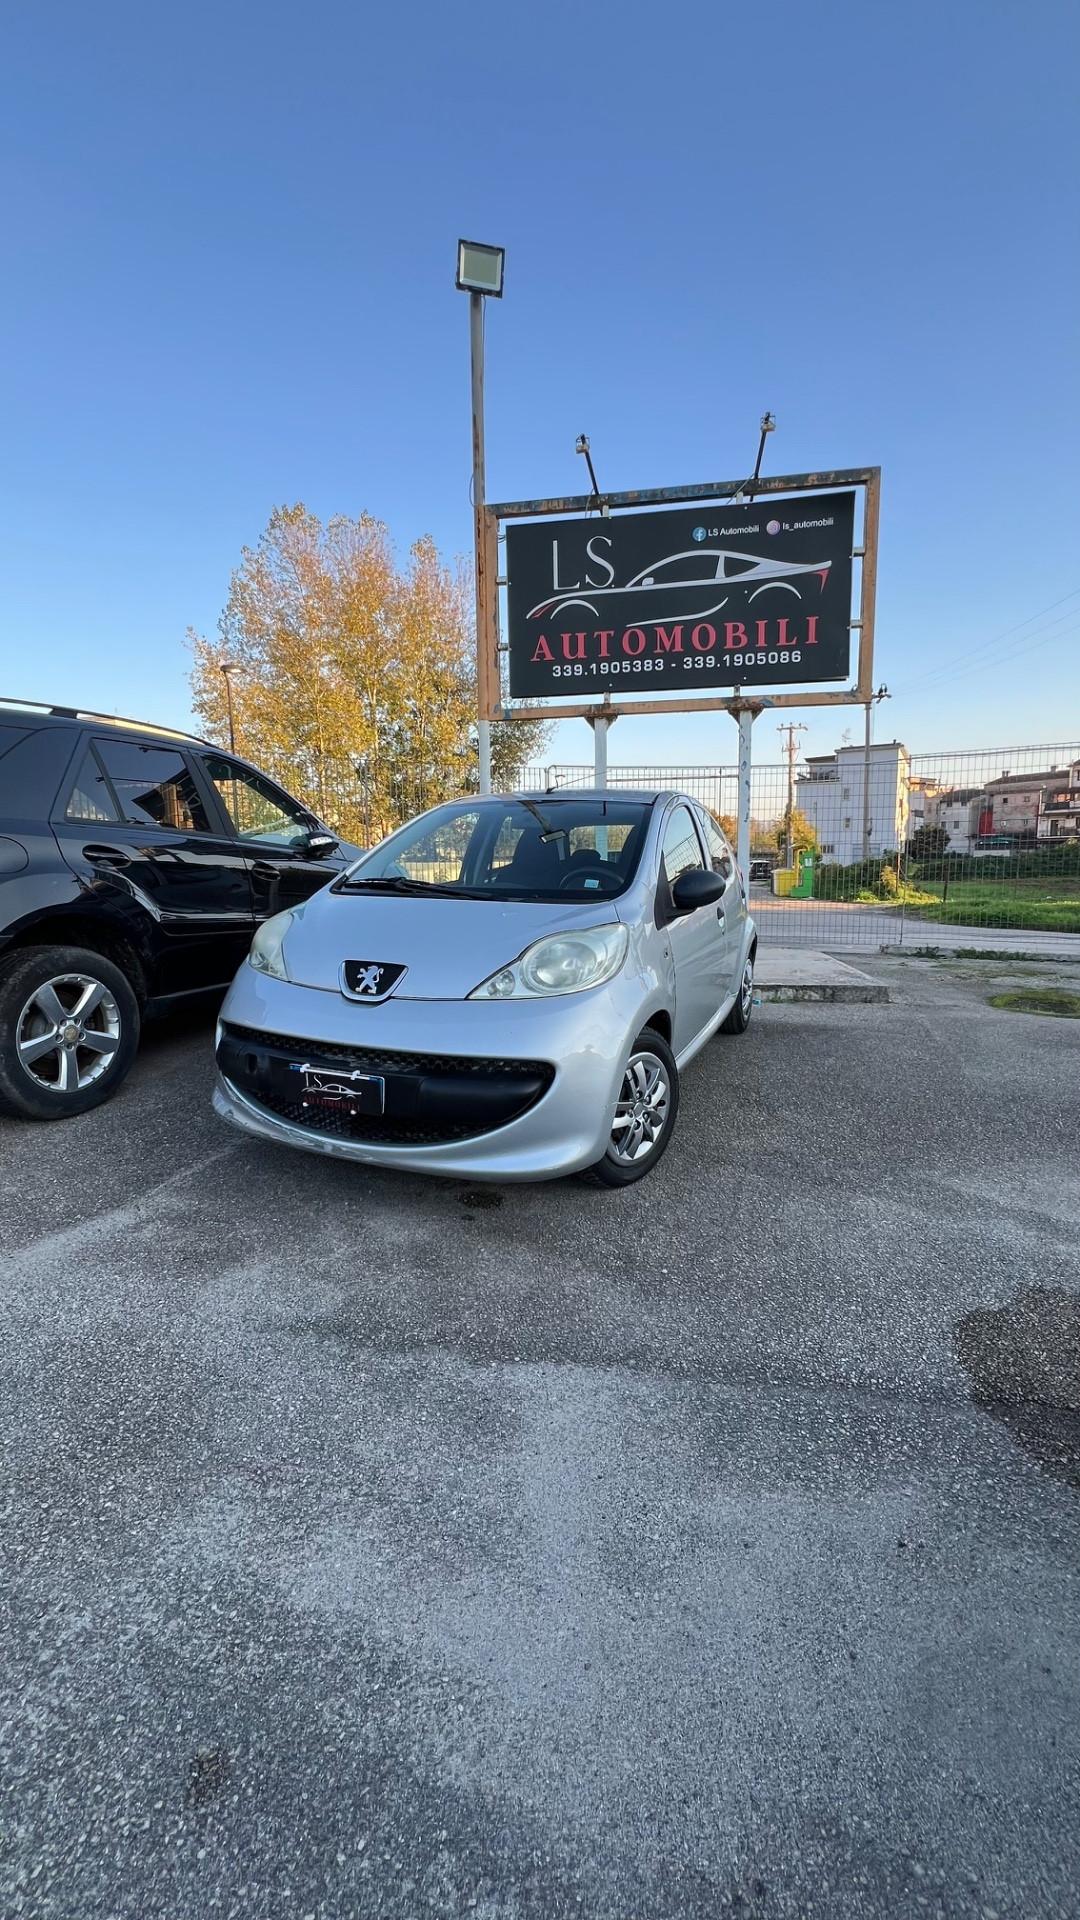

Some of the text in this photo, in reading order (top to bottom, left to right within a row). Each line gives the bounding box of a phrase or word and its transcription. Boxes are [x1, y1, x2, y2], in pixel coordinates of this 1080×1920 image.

[708, 524, 760, 537] LS Automobili
[782, 517, 834, 531] ls_automobili
[530, 616, 819, 662] AUTOMOBILI
[552, 658, 664, 677] 339.1905383
[683, 650, 801, 669] 339.1905086
